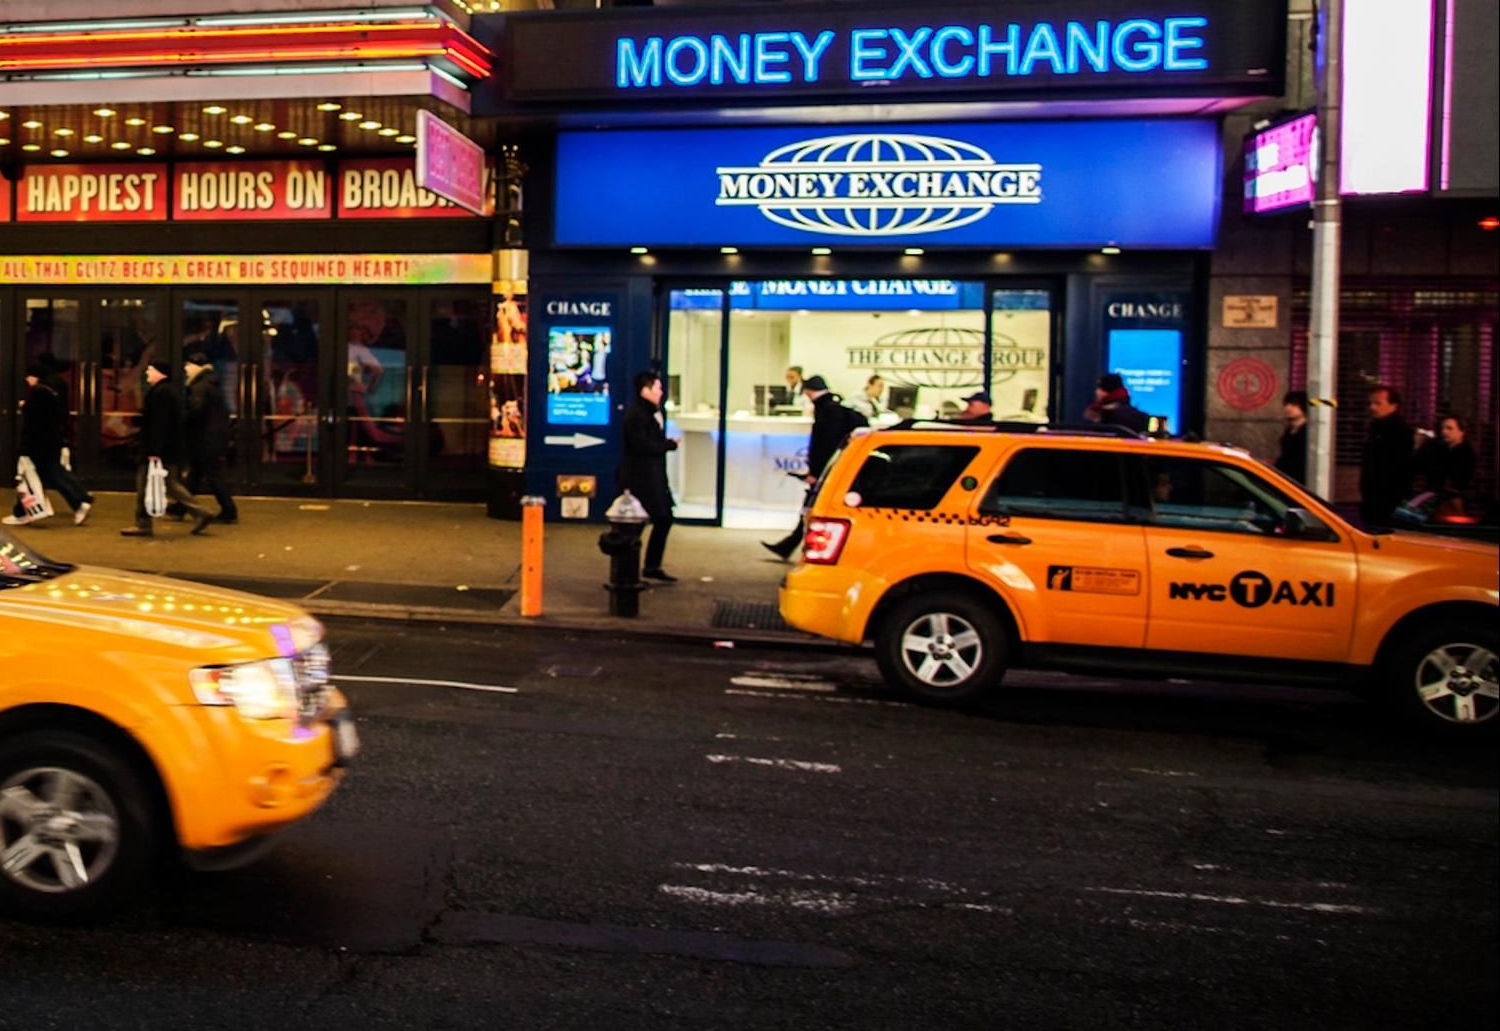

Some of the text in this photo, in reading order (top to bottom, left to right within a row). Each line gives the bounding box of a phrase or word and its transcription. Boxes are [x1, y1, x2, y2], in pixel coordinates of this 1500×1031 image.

[617, 16, 1209, 89] MONEY EXCHANGE
[27, 172, 158, 214] HAPPIEST
[181, 170, 274, 211] HOURS
[285, 168, 326, 210] ON
[720, 170, 1041, 199] MONEY EXCHANGE
[3, 260, 28, 278] ALL
[35, 260, 69, 278] THAT
[75, 260, 117, 278] GLITZ
[122, 260, 165, 278] BEATS
[171, 261, 180, 278] A
[186, 260, 231, 278] GREAT
[239, 260, 264, 278] BIG
[271, 260, 346, 278] SEQUINED
[352, 260, 409, 278] HEART!
[547, 301, 611, 316] CHANGE
[1108, 302, 1183, 318] CHANGE
[848, 348, 970, 367] THE CHANGE
[1169, 580, 1228, 602] NYC
[1229, 570, 1336, 609] TAXI
